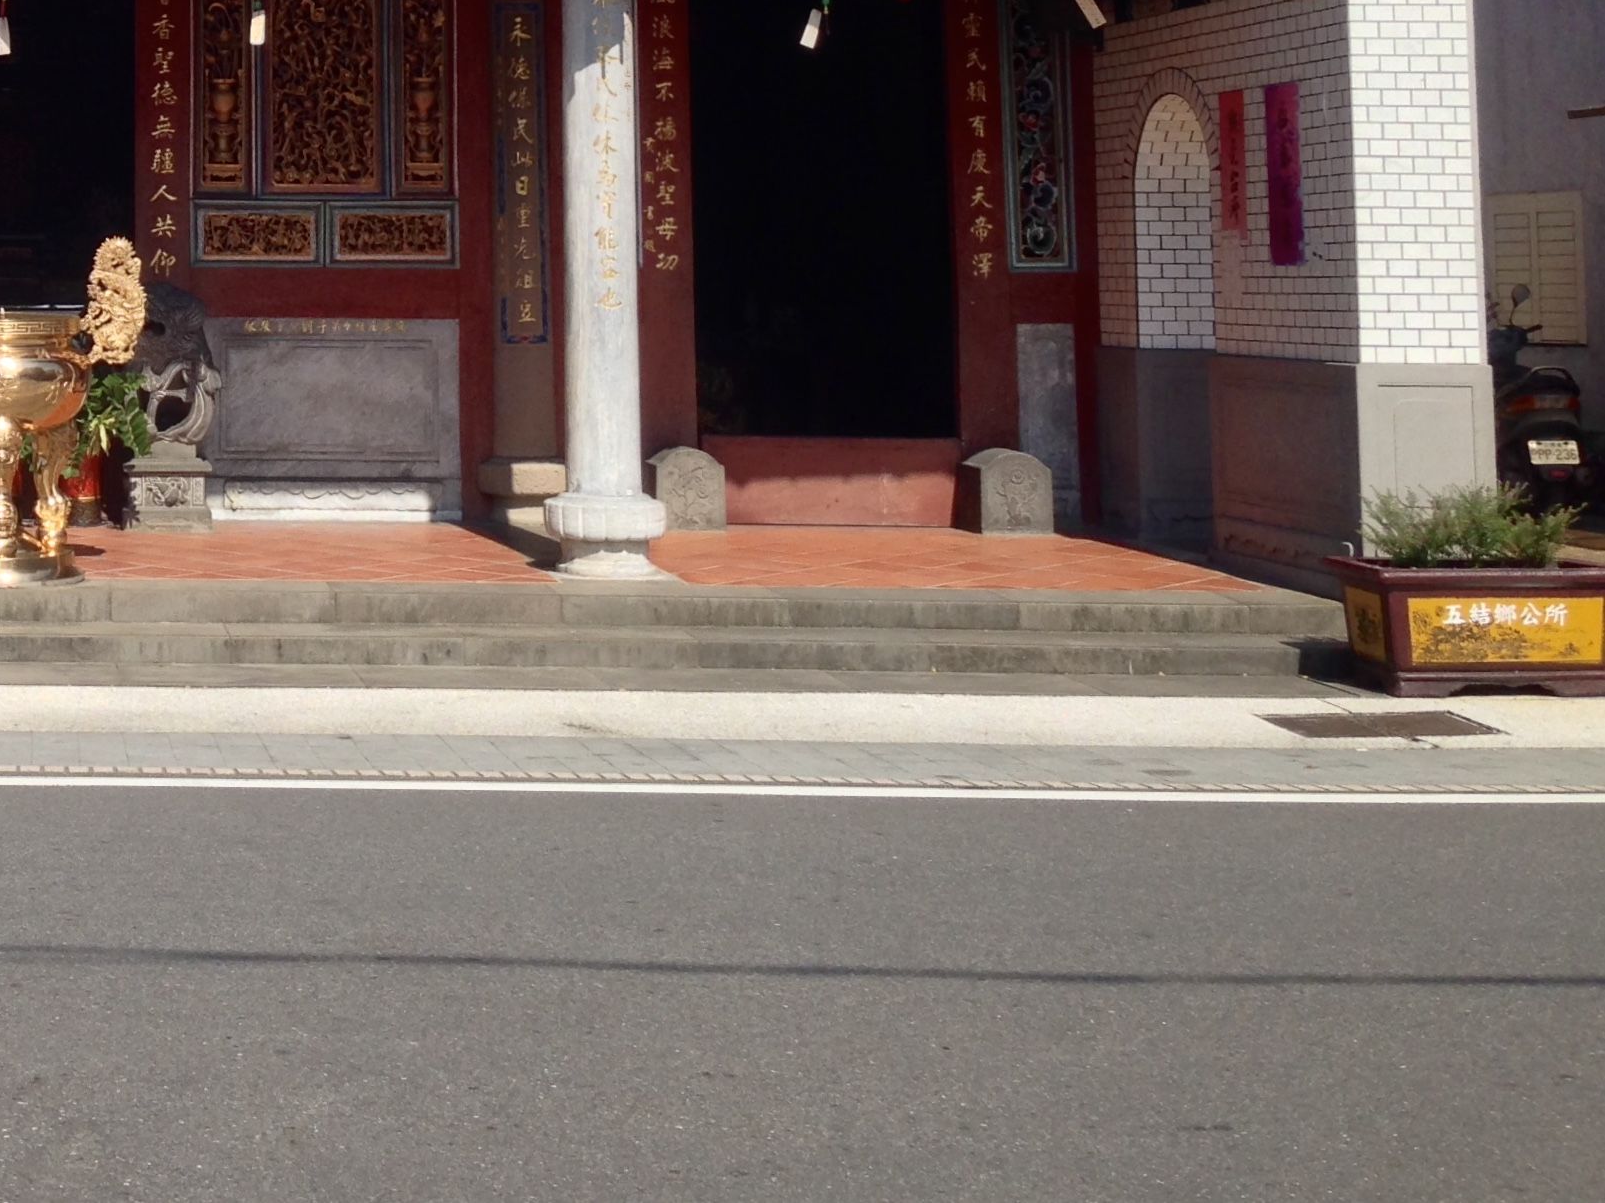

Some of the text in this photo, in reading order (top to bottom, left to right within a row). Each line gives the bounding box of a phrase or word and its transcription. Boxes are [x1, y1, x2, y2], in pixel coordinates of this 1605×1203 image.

[1442, 601, 1569, 627] 五結鄉公所
